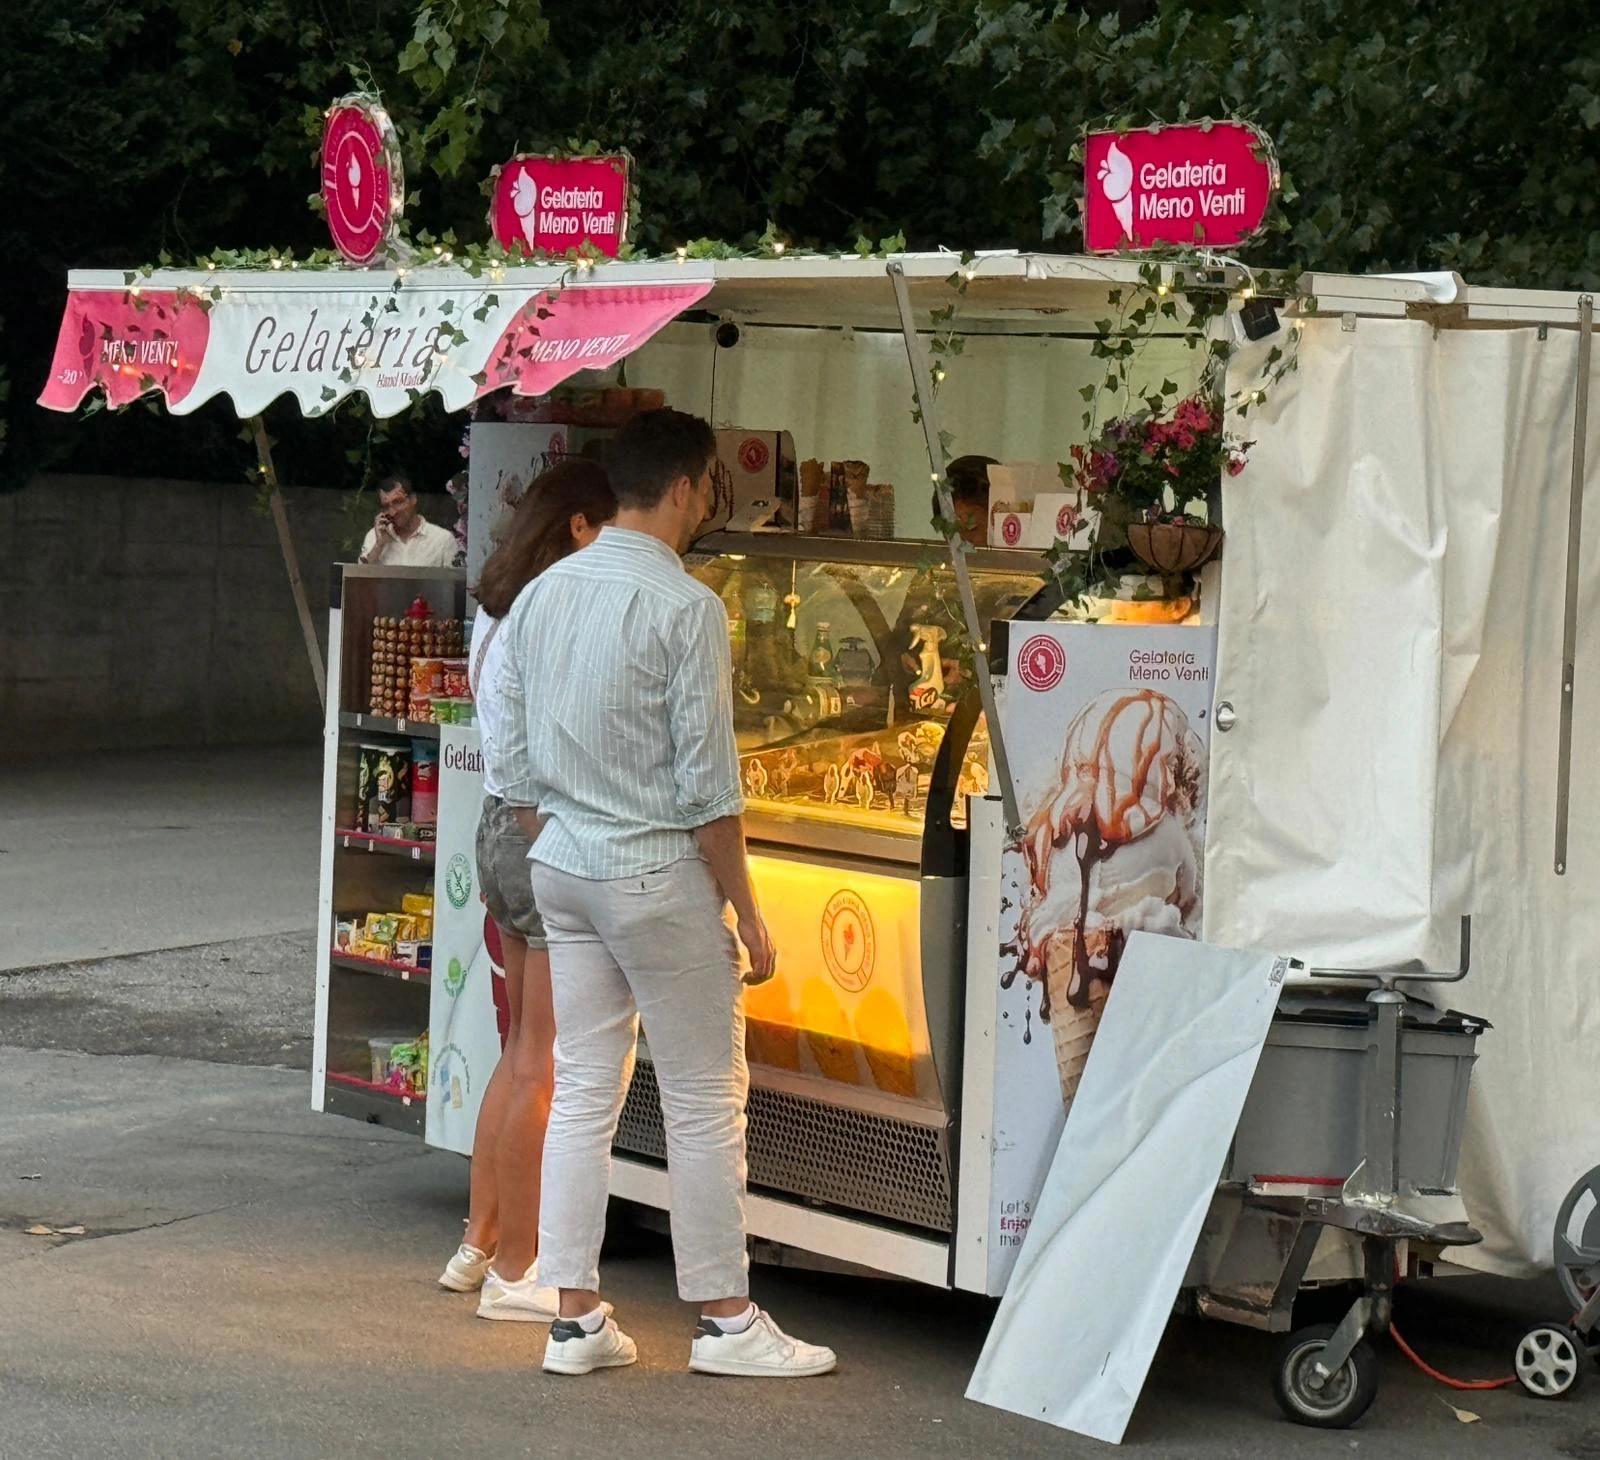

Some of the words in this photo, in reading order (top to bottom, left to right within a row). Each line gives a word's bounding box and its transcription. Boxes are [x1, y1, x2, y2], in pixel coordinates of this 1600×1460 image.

[1139, 158, 1227, 190] Gelateria
[541, 186, 604, 209] Gelateria
[1139, 192, 1194, 220] Meno
[1198, 187, 1246, 217] Venti
[540, 211, 579, 234] Meno
[582, 211, 616, 234] Venti
[245, 307, 444, 374] Gelateria
[530, 338, 580, 362] MENO
[577, 334, 631, 359] VENTI
[1129, 649, 1195, 665] Gelateria
[1129, 665, 1171, 680] Meno
[1175, 666, 1209, 681] Venti
[444, 743, 485, 774] Gelat
[1000, 1199, 1030, 1214] Let's
[1000, 1216, 1031, 1233] Enjo
[999, 1234, 1021, 1246] the
